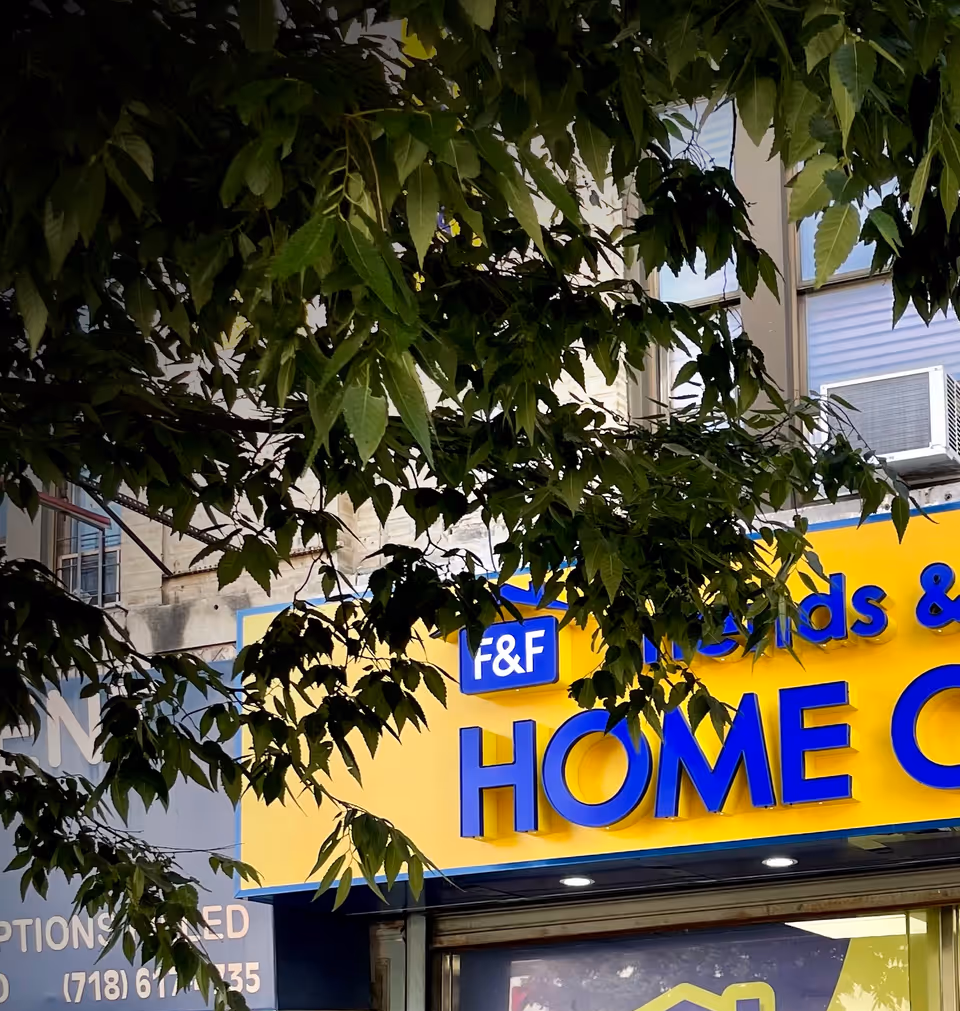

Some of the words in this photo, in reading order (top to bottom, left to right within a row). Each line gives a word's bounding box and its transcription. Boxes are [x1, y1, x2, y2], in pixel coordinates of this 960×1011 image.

[474, 630, 545, 680] F&F
[459, 681, 852, 837] HOME
[62, 969, 127, 1003] (718)
